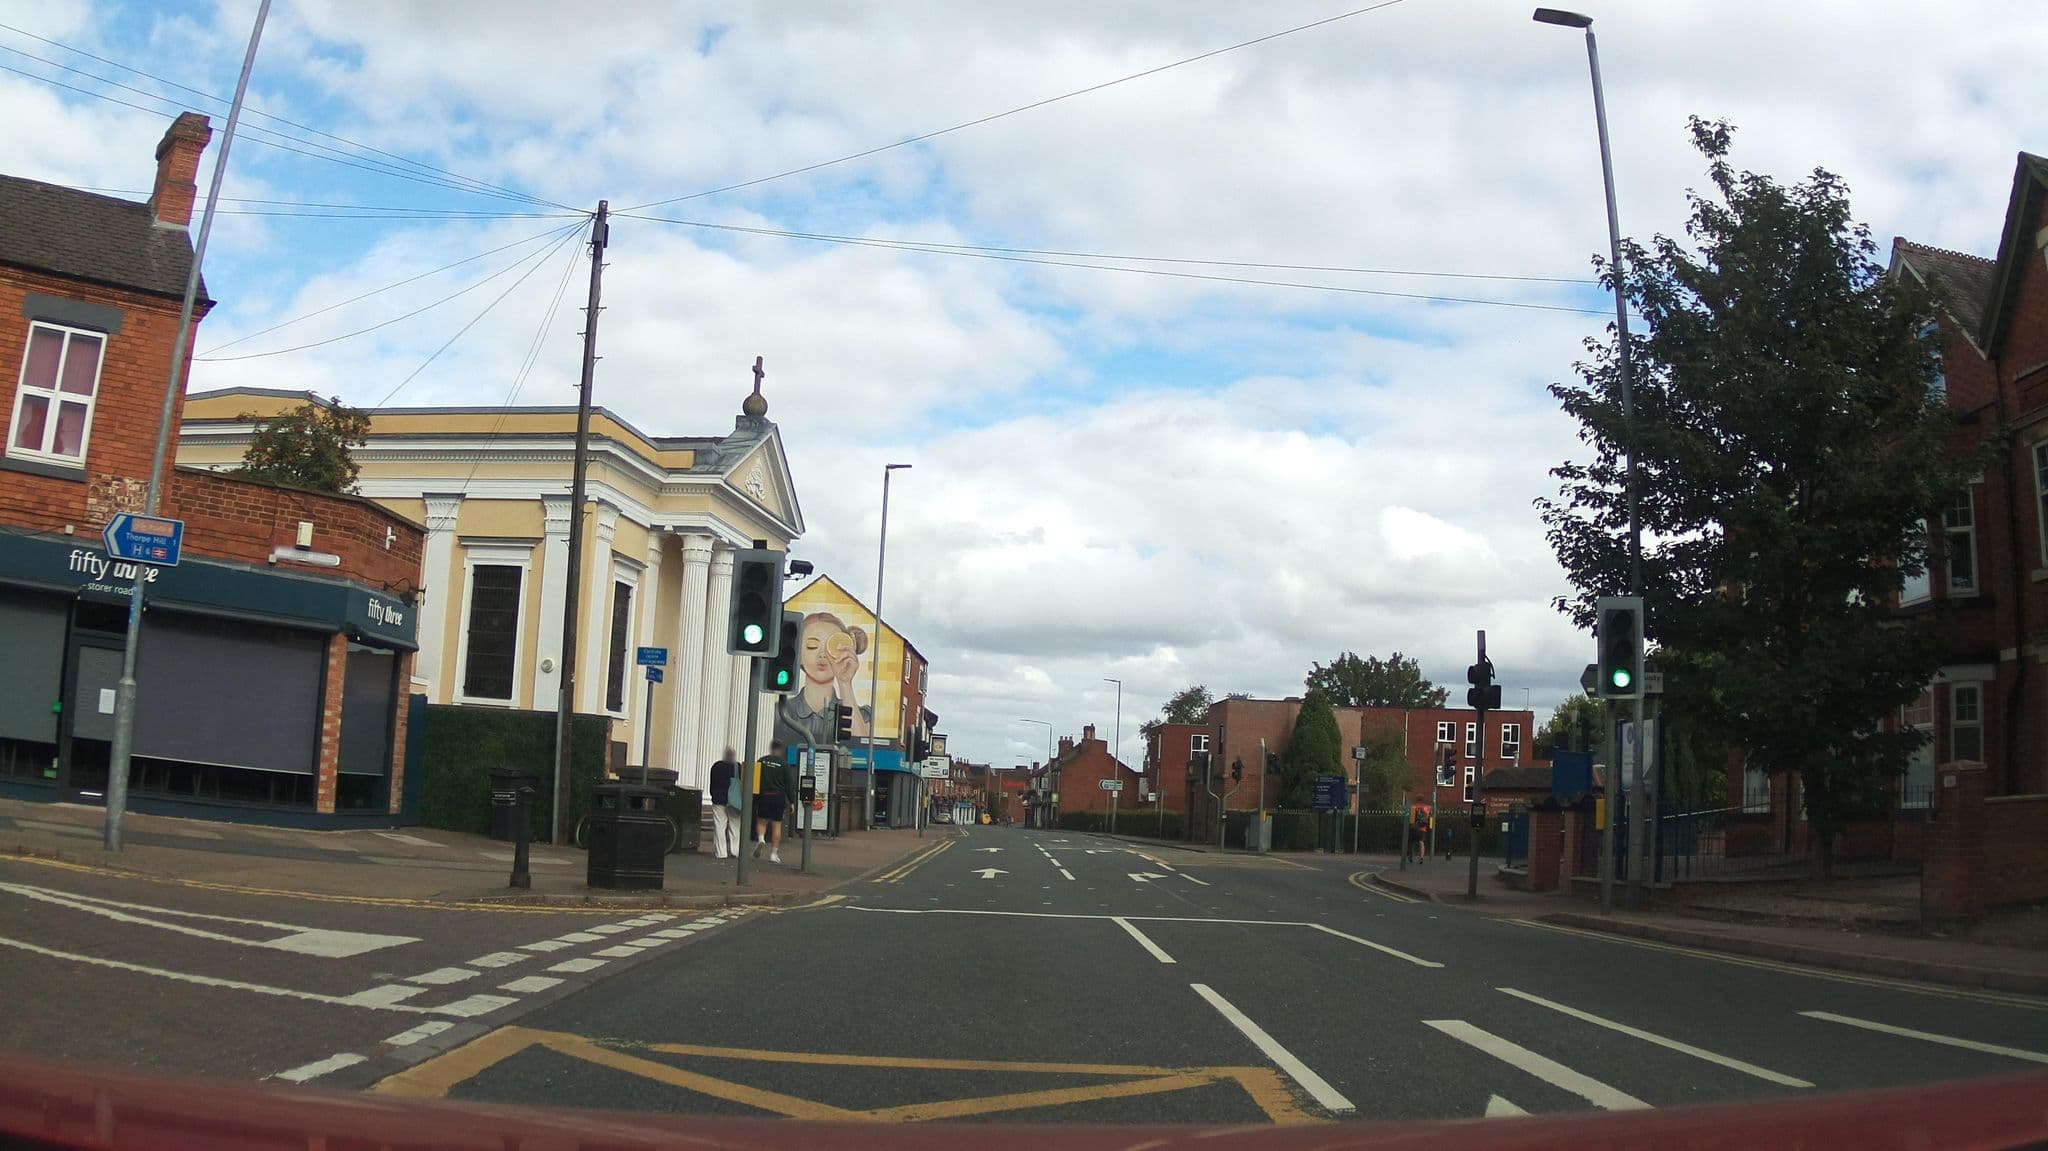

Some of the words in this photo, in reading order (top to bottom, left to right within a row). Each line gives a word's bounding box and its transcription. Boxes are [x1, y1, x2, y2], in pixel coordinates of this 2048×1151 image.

[69, 550, 110, 580] fifty
[88, 583, 112, 593] storer
[114, 586, 133, 595] road
[368, 598, 385, 626] fifty
[384, 605, 403, 626] three
